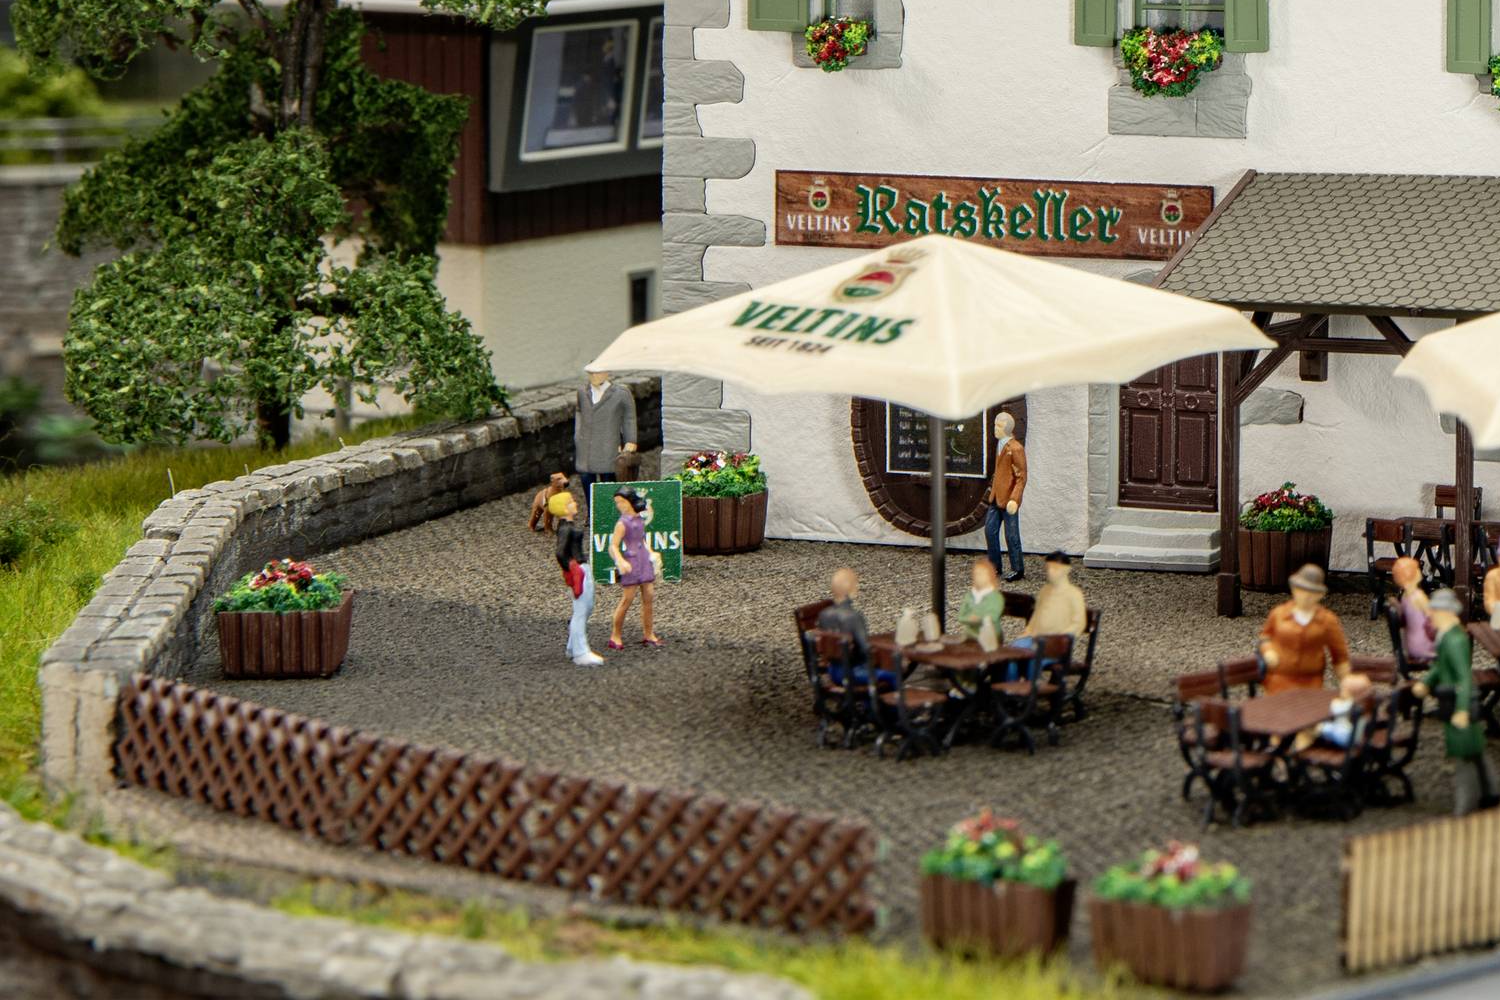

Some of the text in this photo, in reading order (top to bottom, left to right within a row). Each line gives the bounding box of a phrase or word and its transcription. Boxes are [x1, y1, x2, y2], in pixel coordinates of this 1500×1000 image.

[786, 213, 850, 232] VELTINS
[855, 184, 1123, 244] Ratskeller
[731, 301, 914, 344] VELTINS
[593, 531, 681, 553] VINS
